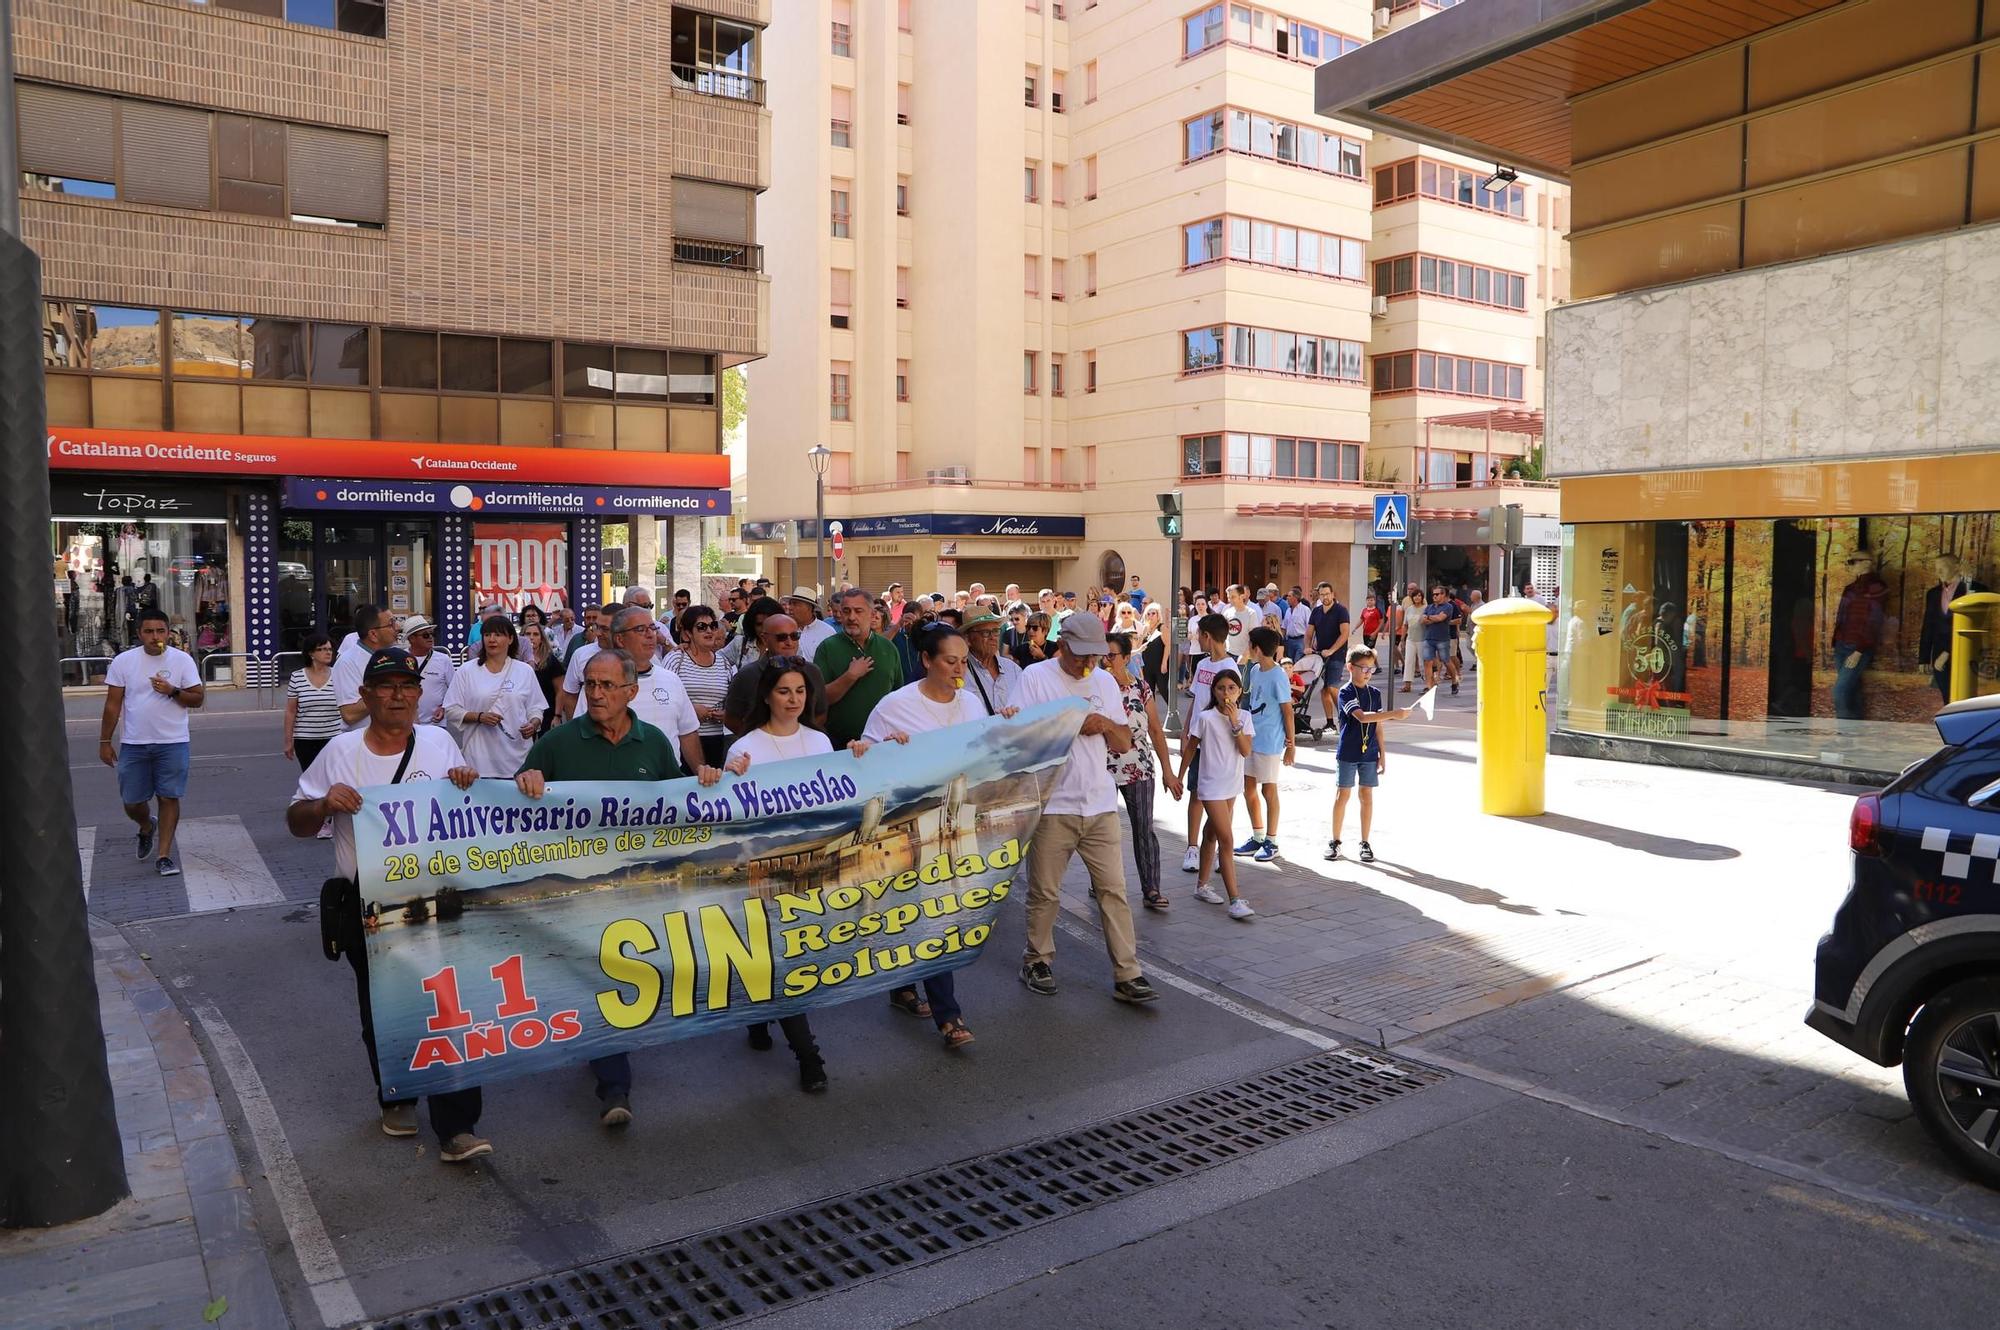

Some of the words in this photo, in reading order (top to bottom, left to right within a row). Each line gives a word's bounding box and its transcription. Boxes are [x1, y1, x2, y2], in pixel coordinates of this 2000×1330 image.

[58, 440, 142, 458] Catalana
[144, 443, 232, 461] Occidente
[234, 452, 276, 463] Seguros
[426, 458, 469, 469] Catalana
[470, 460, 517, 471] Occidente
[336, 488, 435, 503] dormitienda
[484, 491, 584, 506] dormitienda
[613, 495, 699, 509] dormitienda
[981, 517, 1038, 535] Nereida
[474, 538, 566, 590] TODO
[1633, 646, 1665, 674] 50
[379, 799, 419, 848] XI
[427, 795, 592, 842] Aniversario
[598, 796, 678, 828] Riada
[685, 791, 732, 823] San
[732, 768, 857, 819] Wenceslao
[384, 853, 420, 882] 28
[428, 850, 461, 876] de
[467, 835, 608, 873] Septiembre
[615, 831, 645, 852] de
[652, 826, 713, 847] 2023
[780, 878, 1014, 960] Respues
[595, 897, 774, 1030] SIN
[783, 923, 996, 998] Solucio
[409, 1009, 583, 1071] AÑOS
